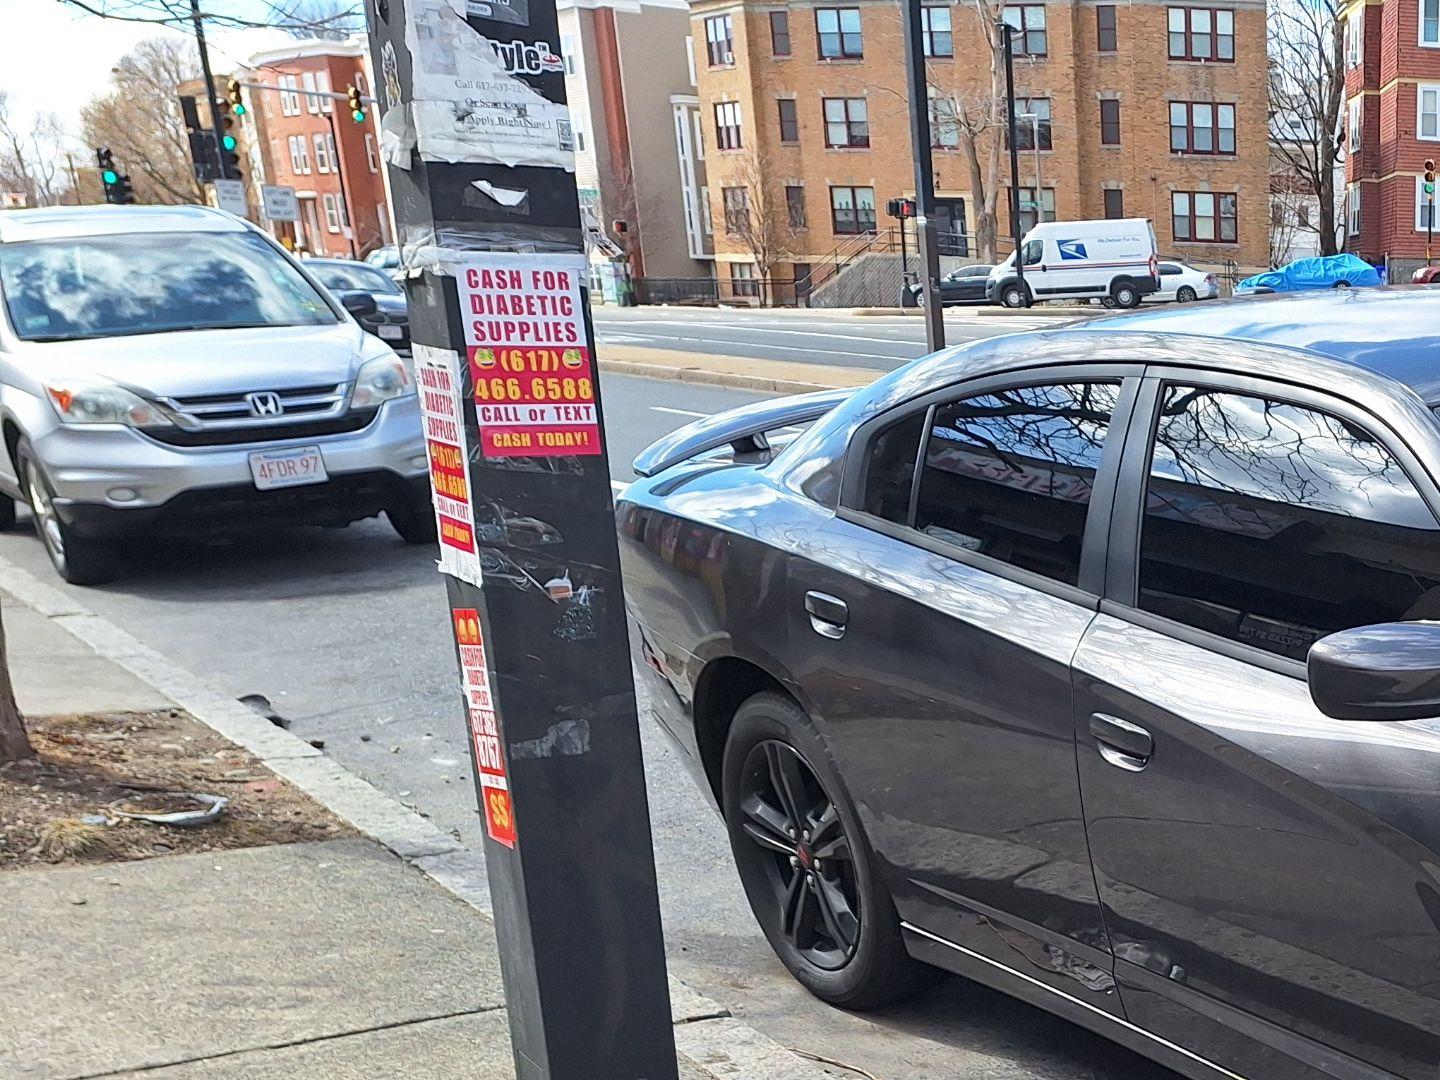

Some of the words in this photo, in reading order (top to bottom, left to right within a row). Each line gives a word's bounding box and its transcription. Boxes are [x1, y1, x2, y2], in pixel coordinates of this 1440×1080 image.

[454, 80, 473, 89] Call
[466, 268, 523, 289] CASH
[531, 270, 570, 291] FOR
[469, 293, 573, 316] DIABETIC
[472, 320, 578, 342] SUPPLIES
[500, 349, 560, 372] (617)
[475, 377, 593, 400] 466.6588
[425, 390, 454, 417] DIABETIC
[481, 406, 521, 421] CALL
[528, 408, 546, 421] or
[553, 405, 592, 421] TEXT
[428, 416, 458, 443] SUPPLIES
[492, 432, 532, 447] CASH
[536, 431, 589, 446] TODAY!
[301, 456, 318, 475] 97
